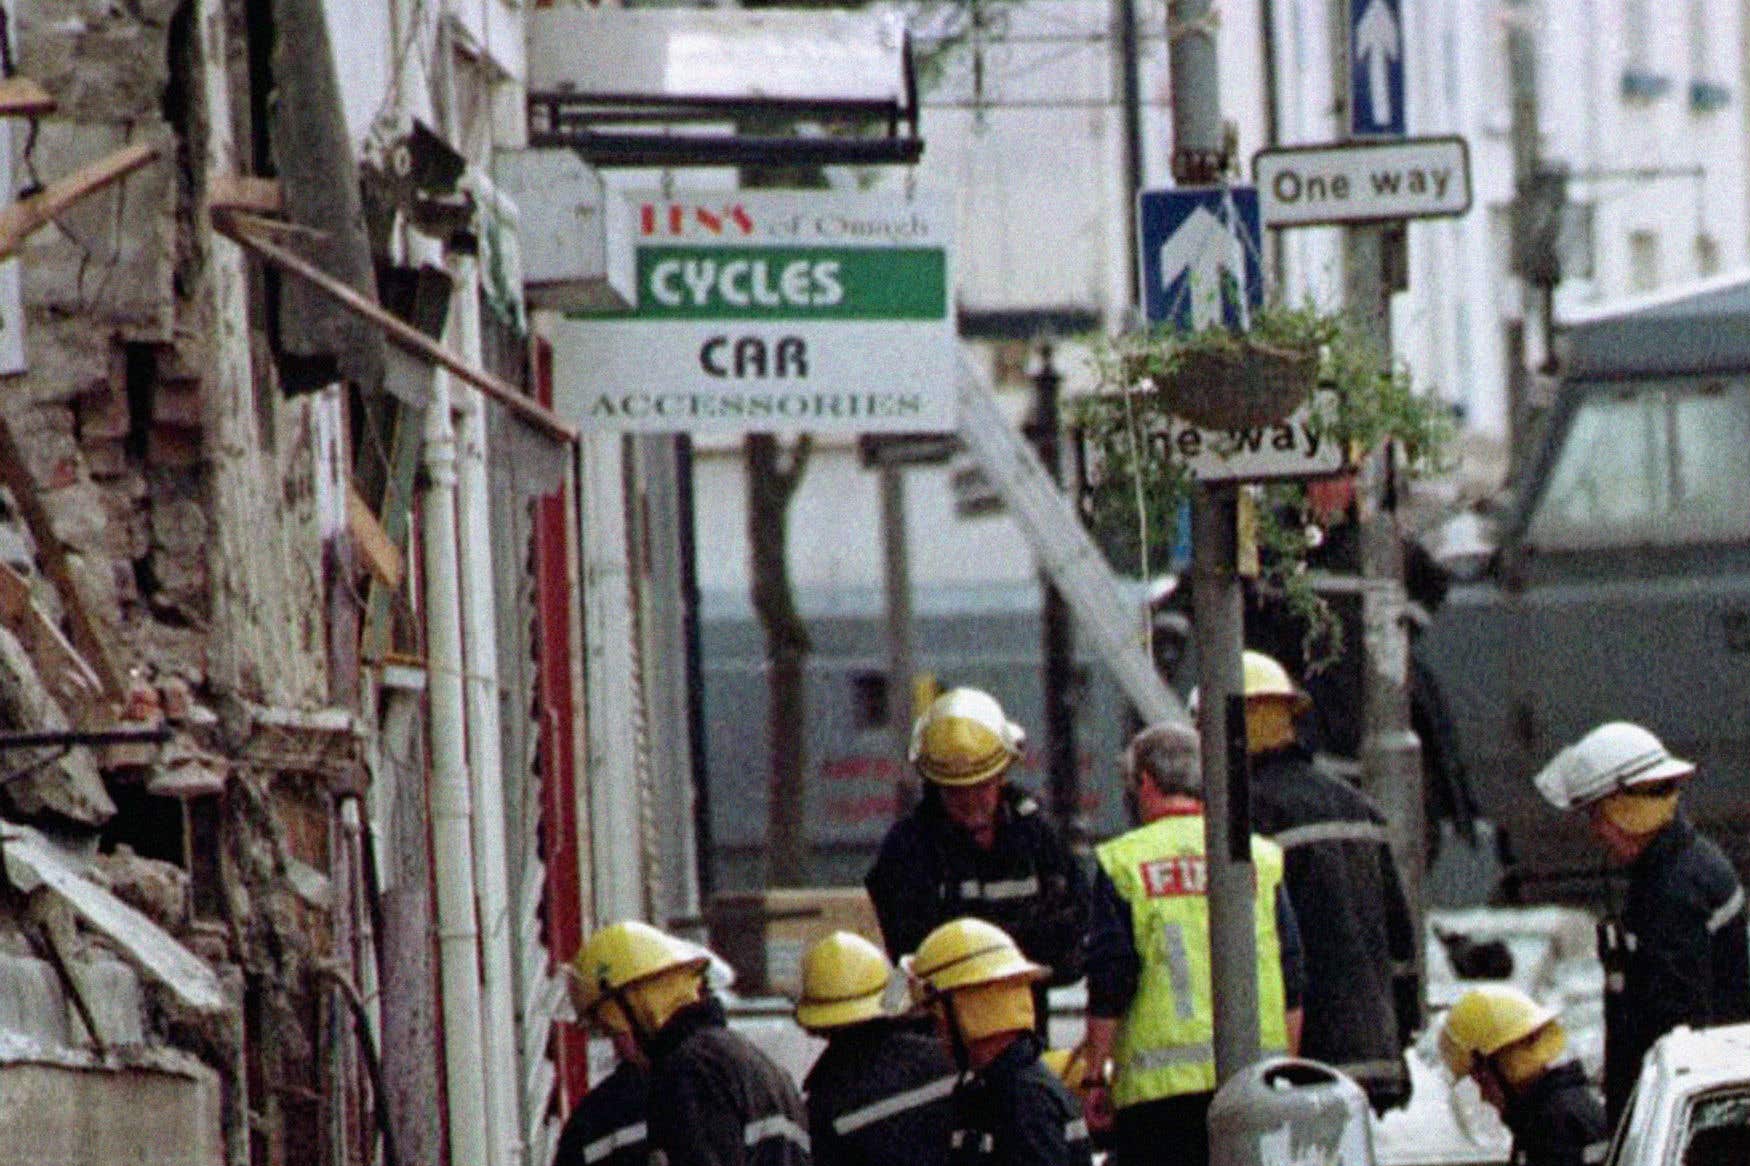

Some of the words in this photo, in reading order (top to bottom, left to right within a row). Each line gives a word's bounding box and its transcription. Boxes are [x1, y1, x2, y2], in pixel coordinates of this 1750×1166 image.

[1272, 169, 1350, 204] One
[1370, 166, 1453, 200] way
[651, 258, 846, 306] CYCLES
[699, 336, 809, 379] CAR
[592, 393, 921, 419] ACCESSORIES
